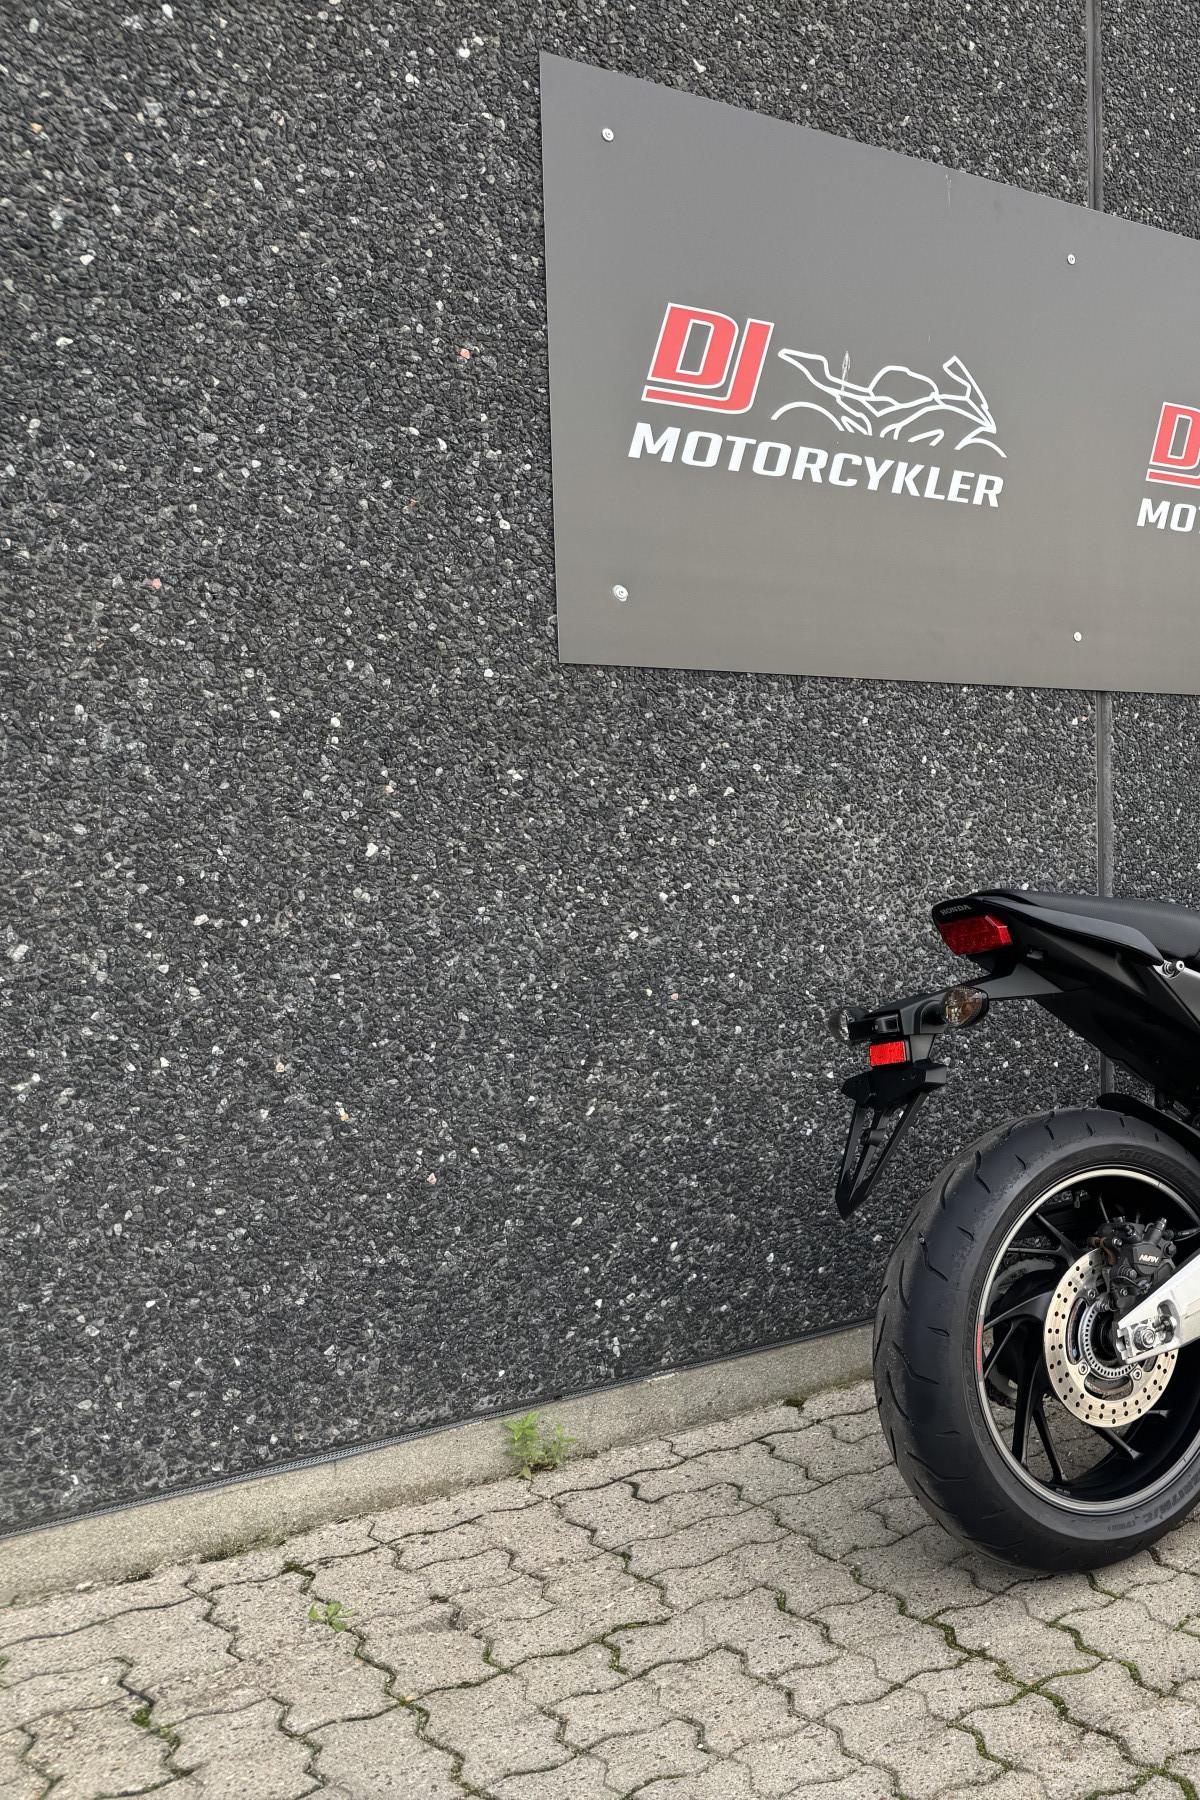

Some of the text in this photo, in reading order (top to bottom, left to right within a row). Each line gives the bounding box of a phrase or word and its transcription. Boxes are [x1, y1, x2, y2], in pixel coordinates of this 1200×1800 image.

[641, 302, 775, 415] DJ
[628, 421, 1004, 508] MOTORCYKLER
[940, 904, 971, 915] HONDA
